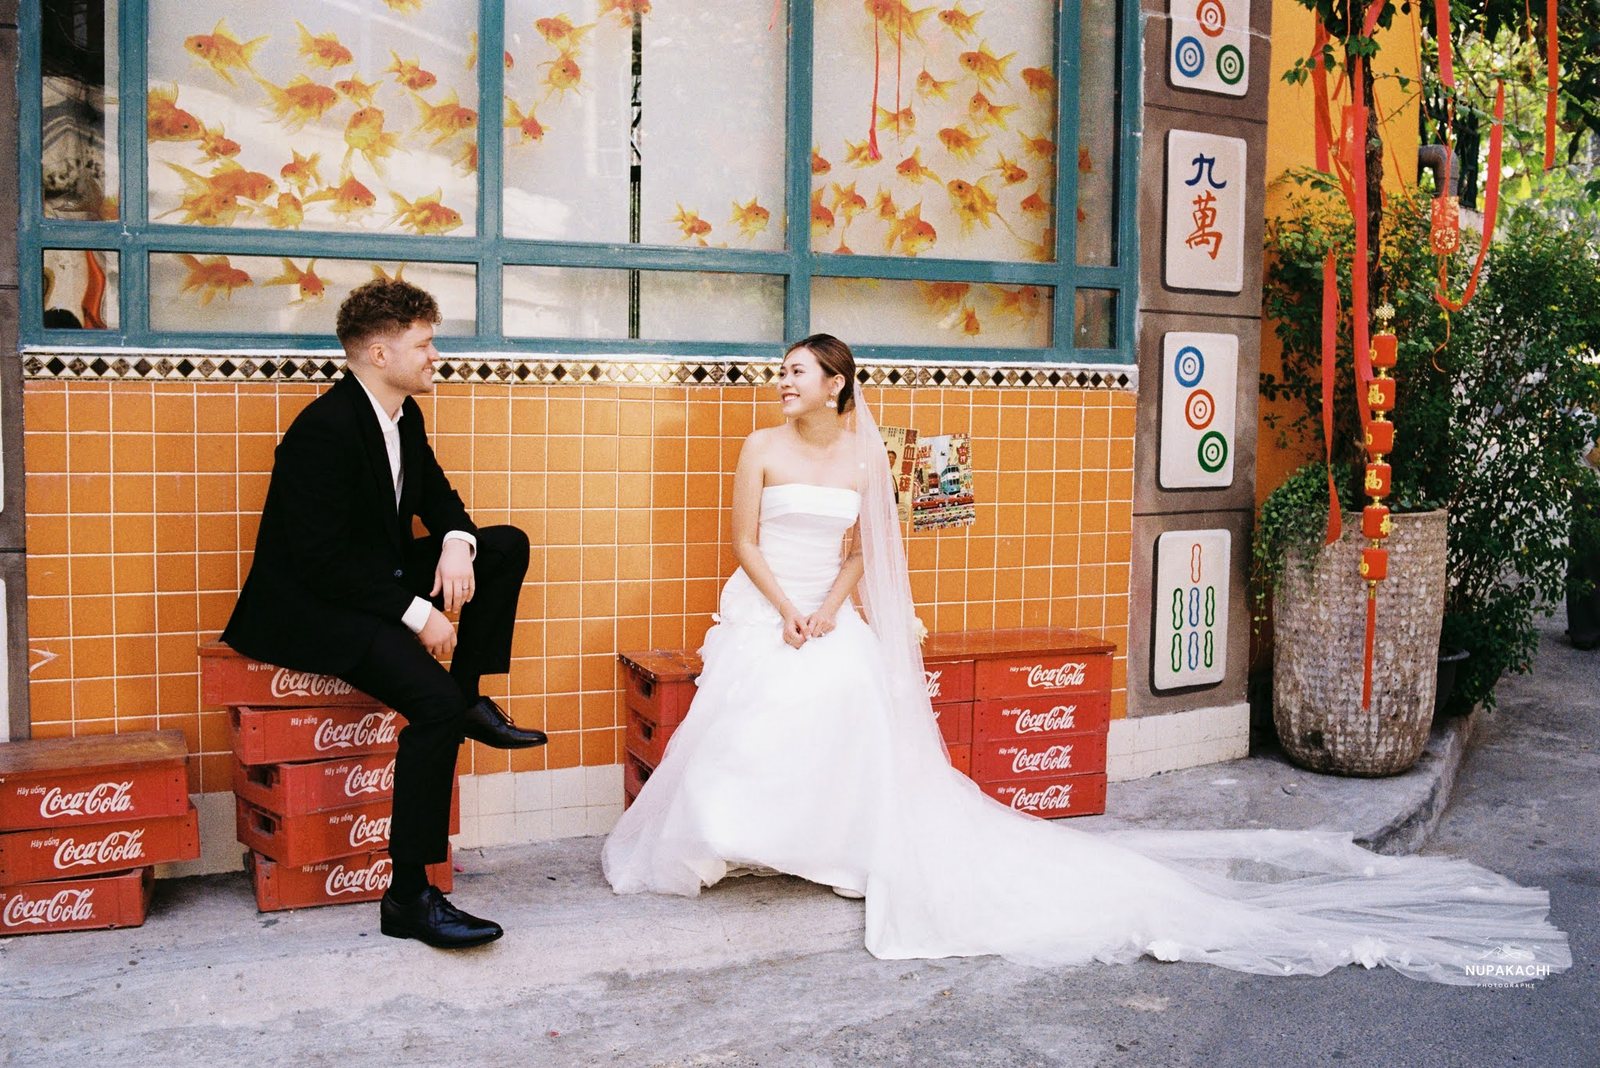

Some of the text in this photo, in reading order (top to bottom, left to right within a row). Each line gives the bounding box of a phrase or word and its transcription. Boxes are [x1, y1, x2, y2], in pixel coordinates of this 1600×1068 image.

[1185, 153, 1227, 260] 九萬
[1028, 663, 1087, 687] Coca-Cola
[314, 712, 397, 751] Coca-Cola
[1015, 705, 1077, 734] Coca-Cola
[1012, 744, 1074, 773] Coca-Cola
[344, 759, 396, 797] Coca-C
[40, 781, 133, 818] Coca-Cola
[1010, 784, 1073, 811] Coca-Cola
[54, 828, 145, 869] Coca-Cola
[325, 858, 393, 896] Coca-Co
[3, 888, 94, 927] Coca-Cola
